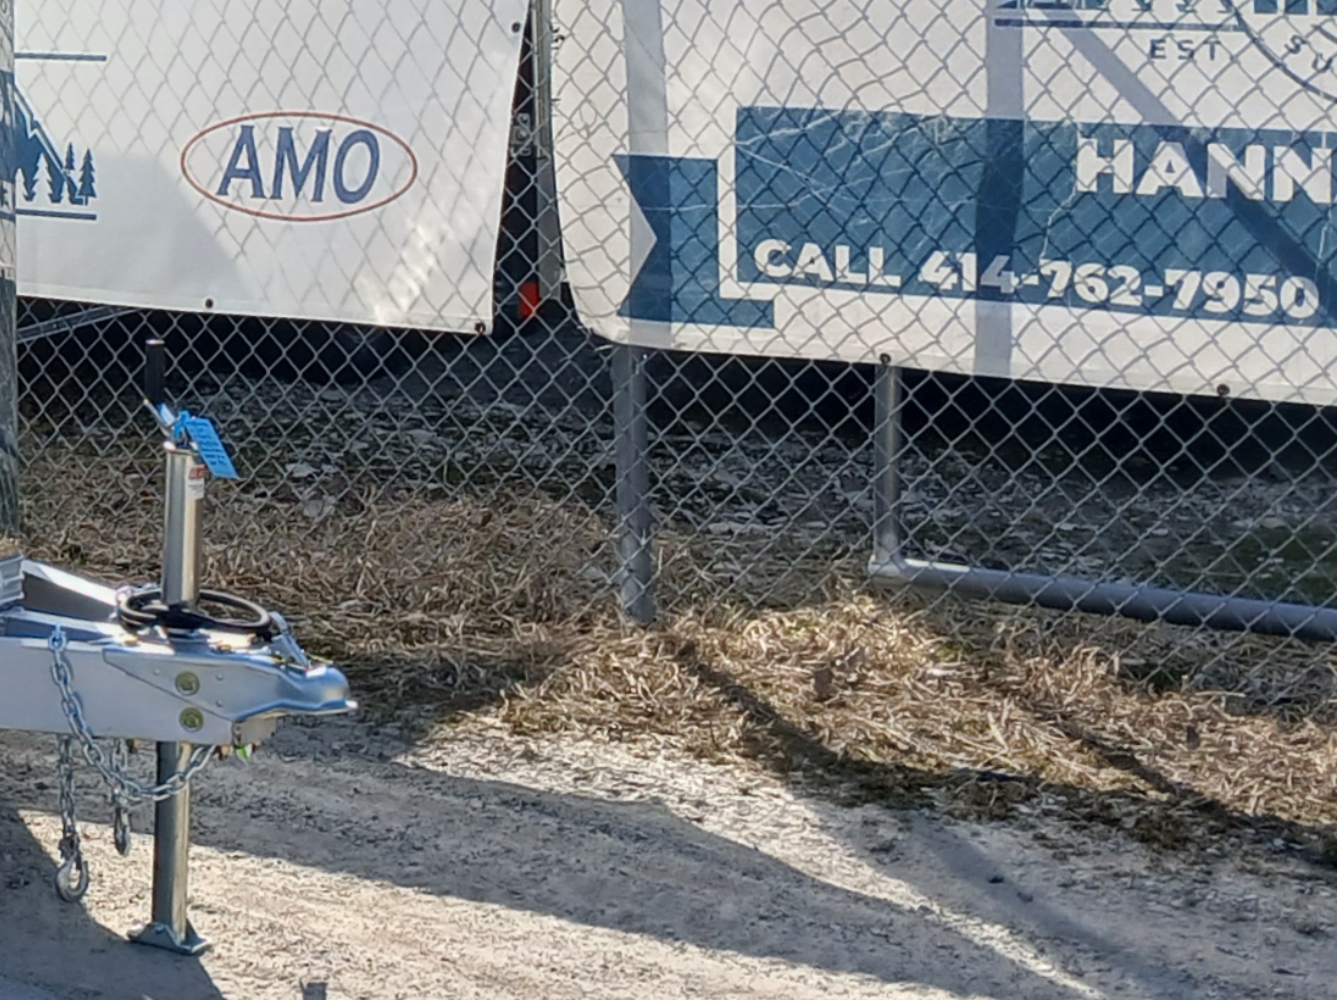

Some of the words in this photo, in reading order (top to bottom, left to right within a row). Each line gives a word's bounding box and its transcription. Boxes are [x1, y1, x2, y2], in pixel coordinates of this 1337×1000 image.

[1149, 38, 1222, 61] EST
[216, 125, 380, 204] AMO
[754, 238, 902, 287] CALL
[922, 249, 1321, 319] 414-762-7950
